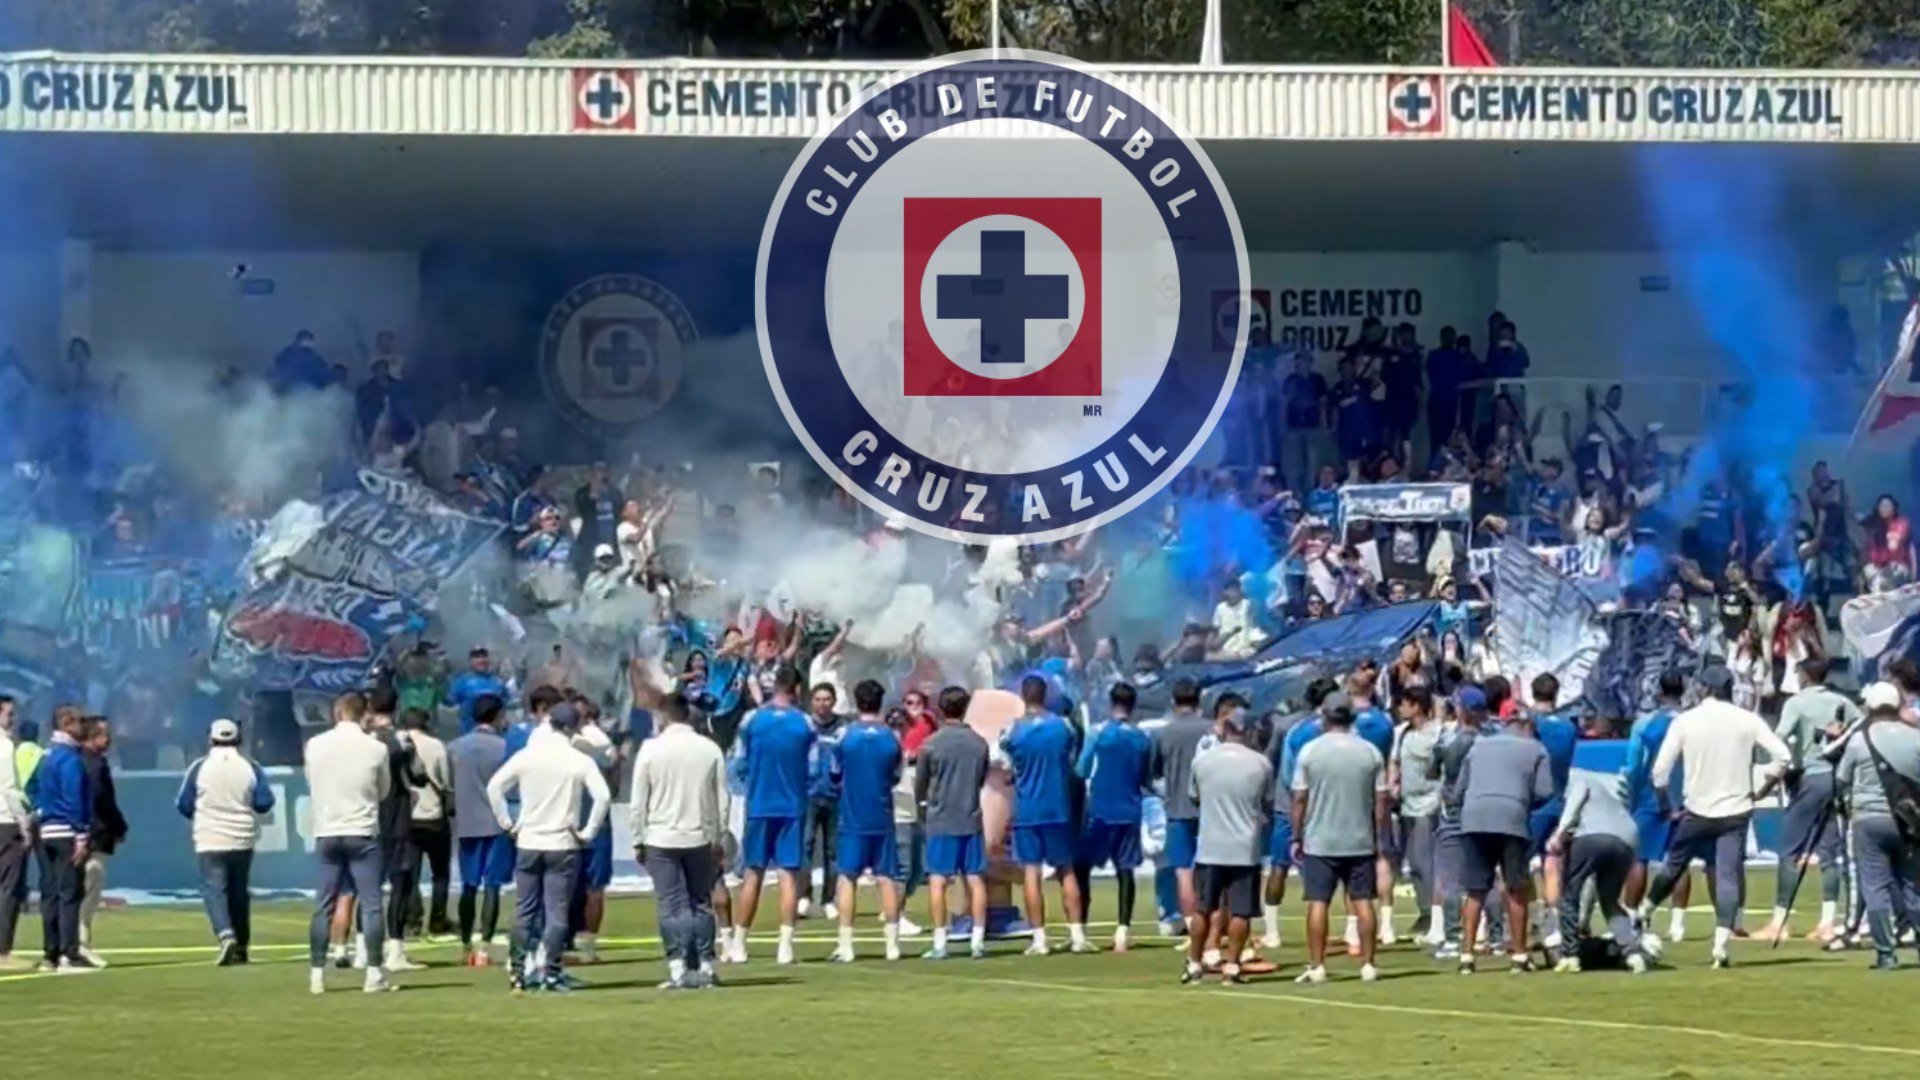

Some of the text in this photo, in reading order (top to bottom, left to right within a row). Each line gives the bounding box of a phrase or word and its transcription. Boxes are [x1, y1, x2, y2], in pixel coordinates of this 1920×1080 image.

[22, 71, 135, 112] CRUZ
[144, 74, 248, 114] AZUL
[647, 79, 851, 118] CEMENTO
[1451, 84, 1843, 124] CEMENTO CRUZ AZUL
[1280, 288, 1422, 317] CEMENTO
